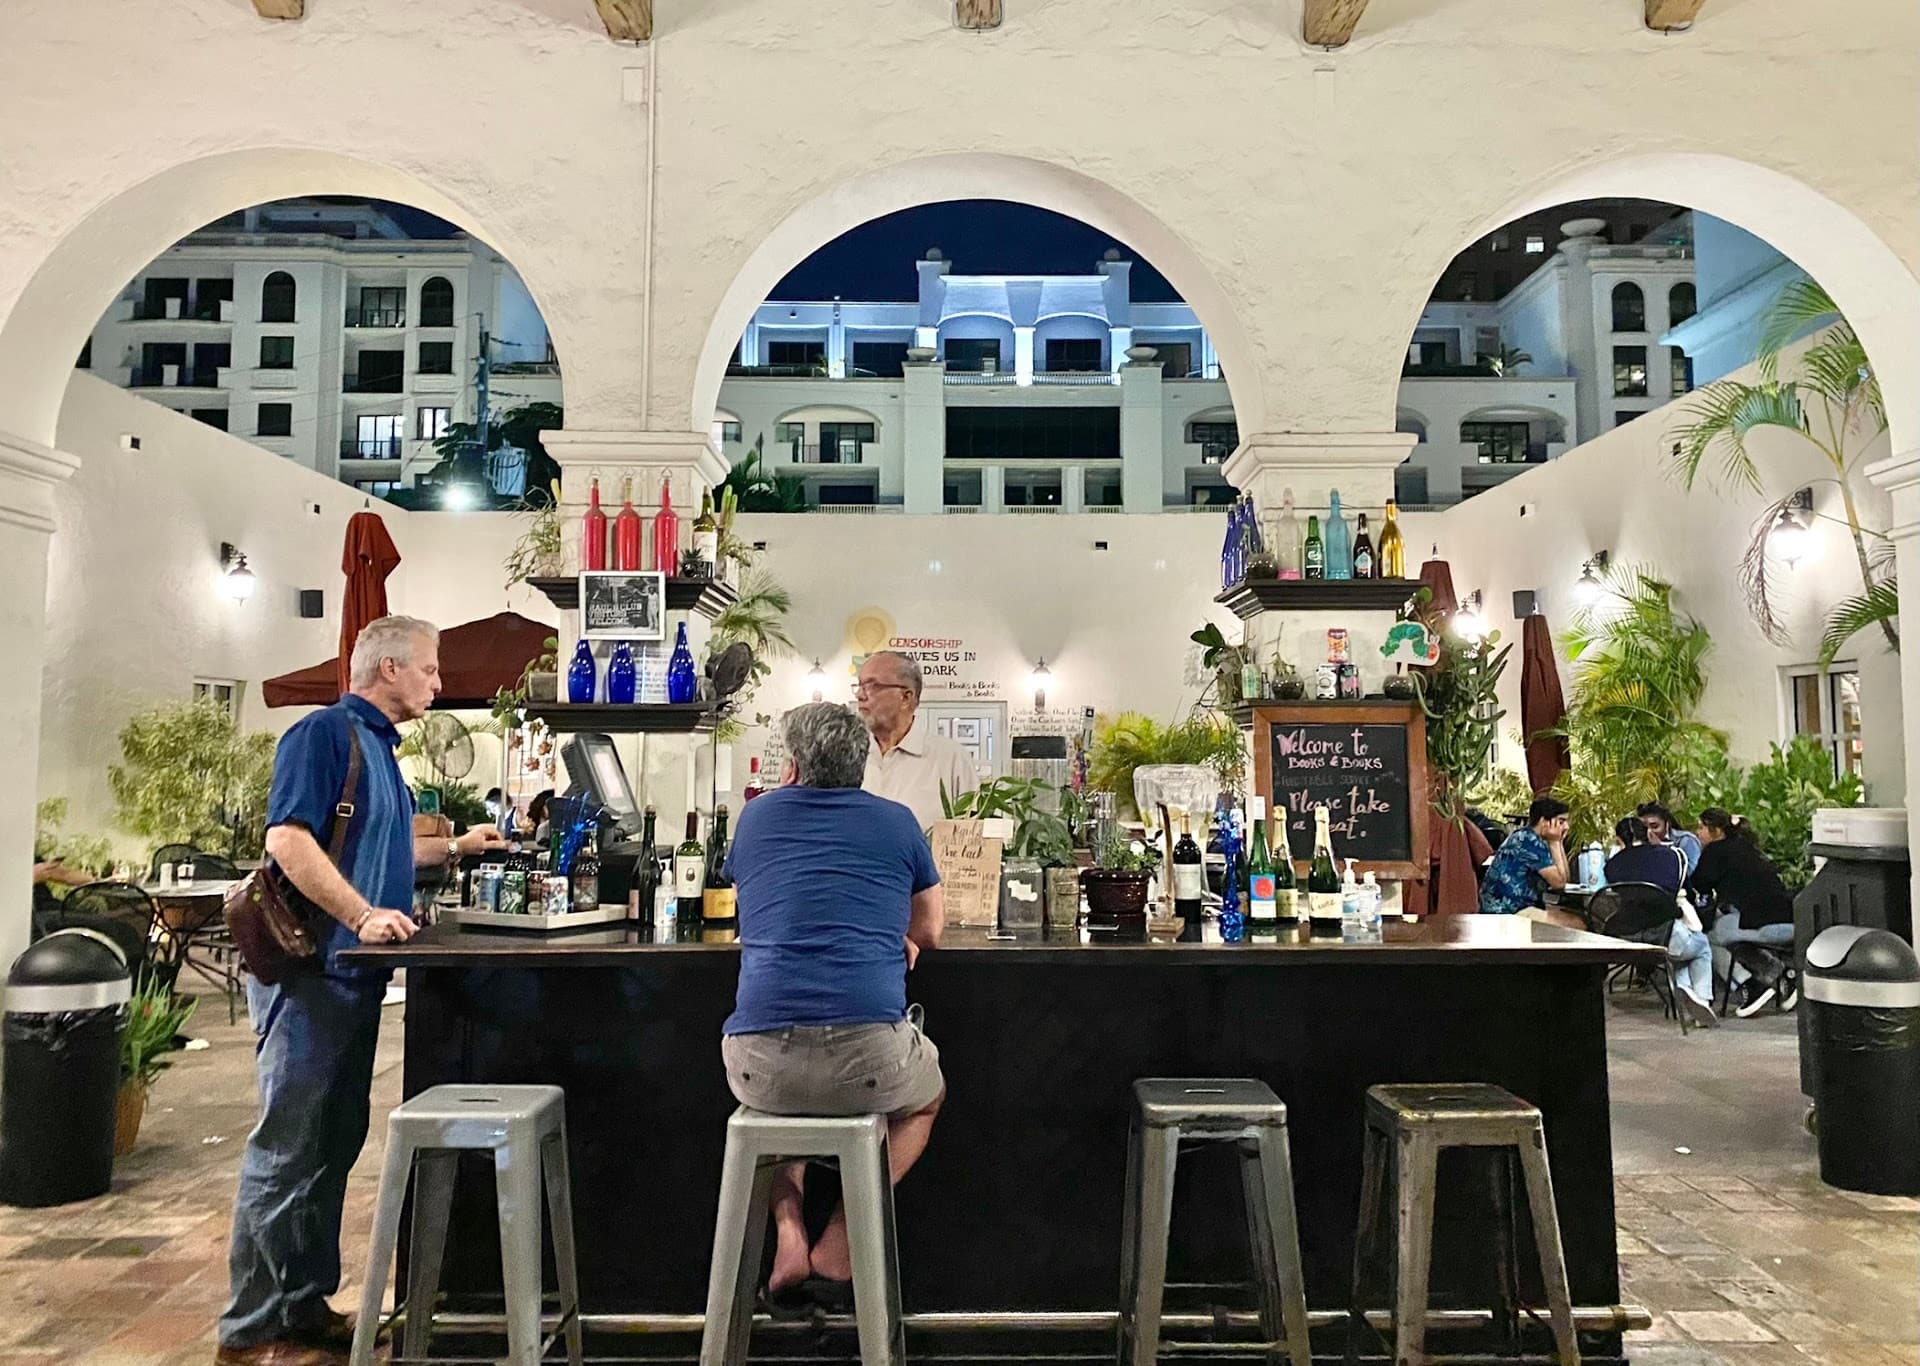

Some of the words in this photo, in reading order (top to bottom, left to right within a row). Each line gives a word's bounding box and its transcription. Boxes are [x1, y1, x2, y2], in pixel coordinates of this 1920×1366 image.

[588, 617, 630, 625] WELCOME
[888, 637, 963, 649] CENSORSHIP
[899, 651, 940, 662] AVES
[944, 651, 960, 662] US
[963, 651, 977, 662] IN
[923, 665, 958, 676] DARK
[1276, 728, 1343, 756] Welcome
[1351, 728, 1369, 756] to
[1289, 788, 1343, 814] Please
[1347, 785, 1391, 816] take
[1292, 820, 1307, 830] a
